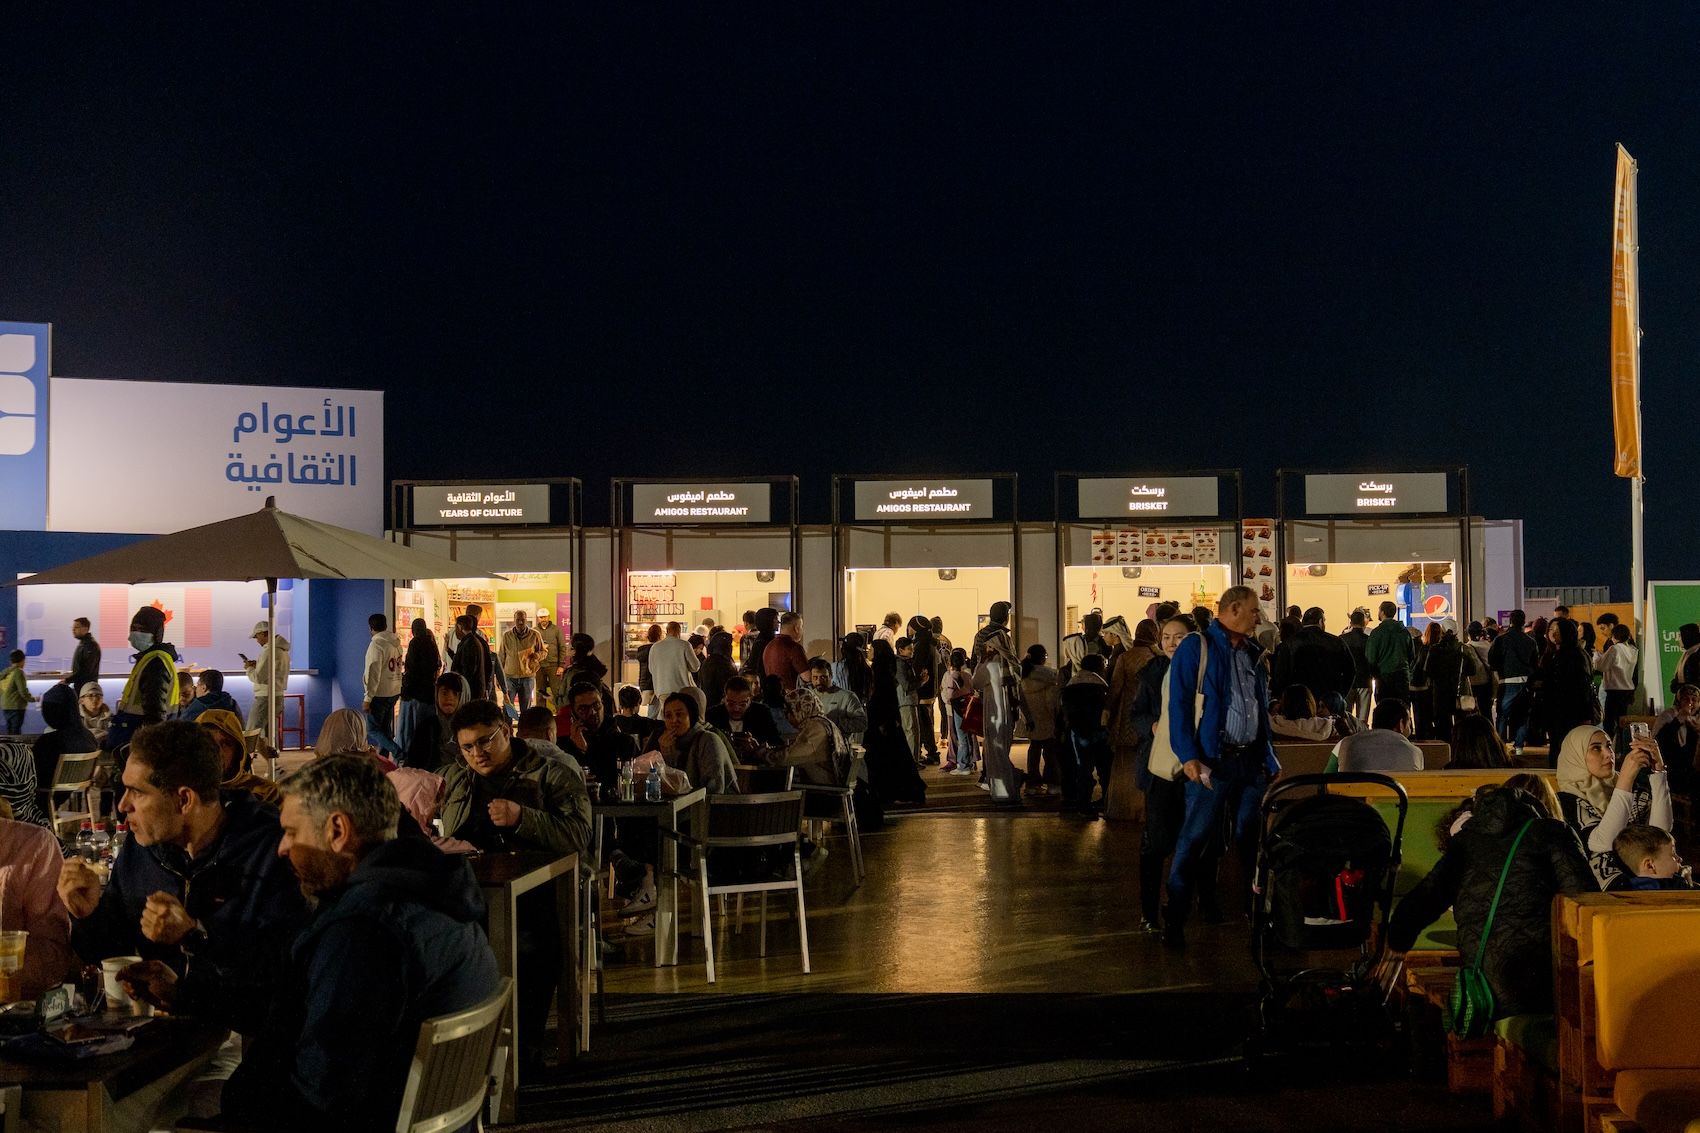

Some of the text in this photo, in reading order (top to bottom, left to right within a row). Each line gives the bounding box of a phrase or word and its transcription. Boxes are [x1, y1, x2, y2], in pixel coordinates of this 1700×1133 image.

[233, 398, 355, 443] الأعوام
[225, 452, 356, 491] الثقافية
[928, 486, 958, 500] مطعم
[1131, 484, 1165, 498] برسكت
[1358, 480, 1393, 494] برسكت
[446, 491, 482, 505] الثقافية
[705, 490, 736, 504] مطعم
[1356, 497, 1397, 507] BRISKET
[439, 508, 523, 518] YEARS OF CULTURE
[654, 507, 749, 516] AMIGOS RESTAURANT
[876, 503, 972, 513] AMIGOS RESTAURANT
[1128, 501, 1169, 511] BRISKET
